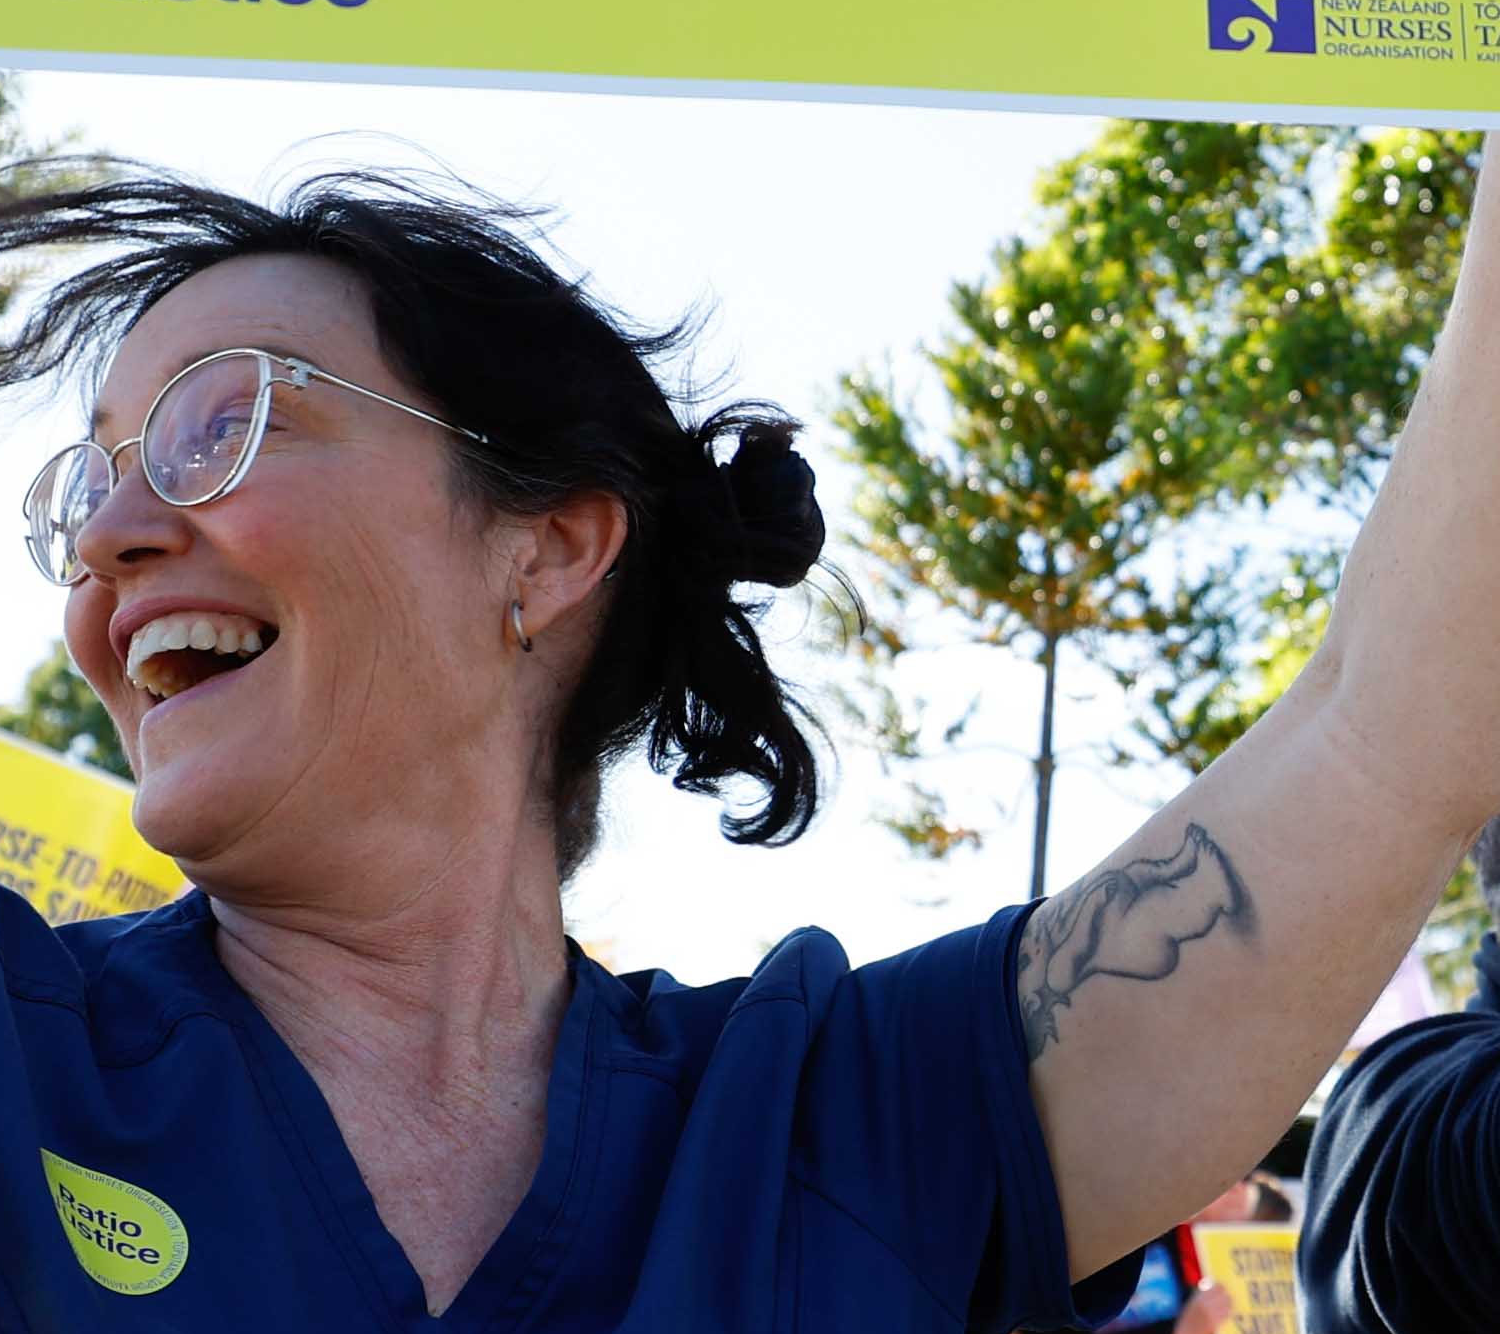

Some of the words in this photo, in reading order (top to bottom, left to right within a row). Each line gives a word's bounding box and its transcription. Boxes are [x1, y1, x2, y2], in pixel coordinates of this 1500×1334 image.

[1323, 16, 1452, 42] NURSES
[1323, 42, 1453, 60] ORGANISATION
[58, 1181, 142, 1238] Ratio
